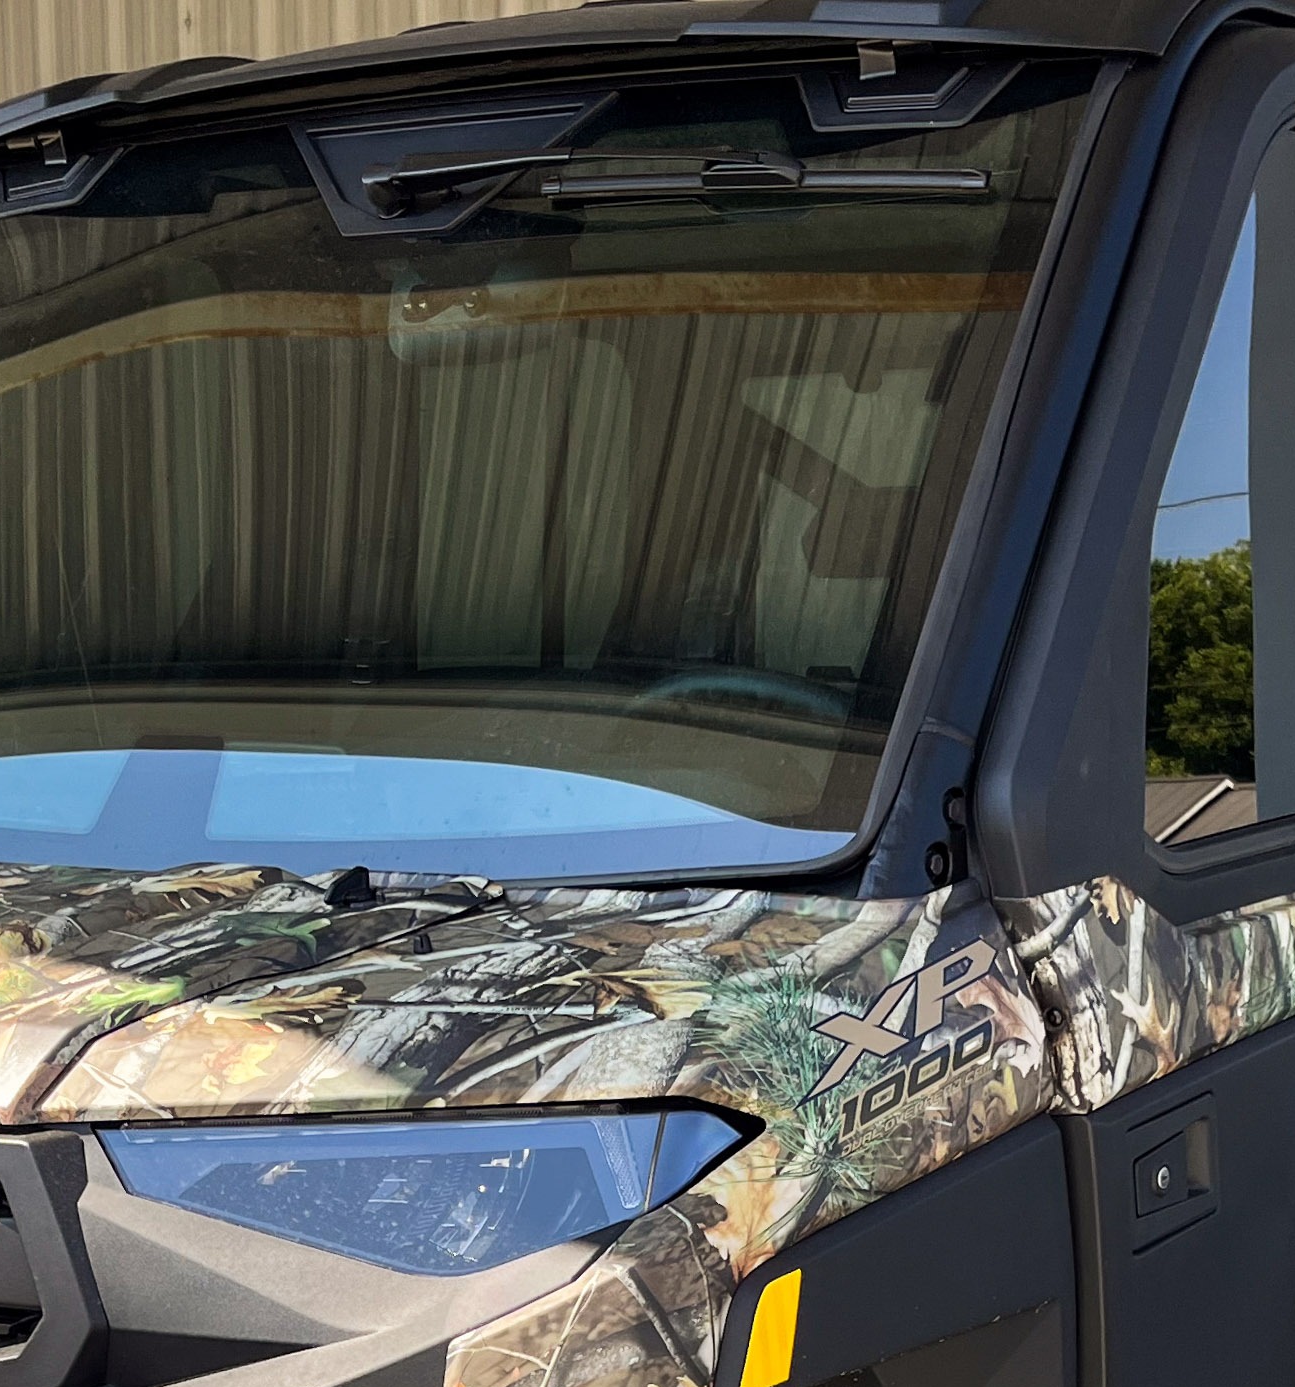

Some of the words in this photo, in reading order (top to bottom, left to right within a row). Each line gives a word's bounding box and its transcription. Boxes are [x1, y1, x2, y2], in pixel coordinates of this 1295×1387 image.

[798, 936, 998, 1106] XP
[838, 1016, 996, 1144] 1000
[841, 1127, 884, 1157] DUAL
[884, 1077, 963, 1131] OVERHEAD
